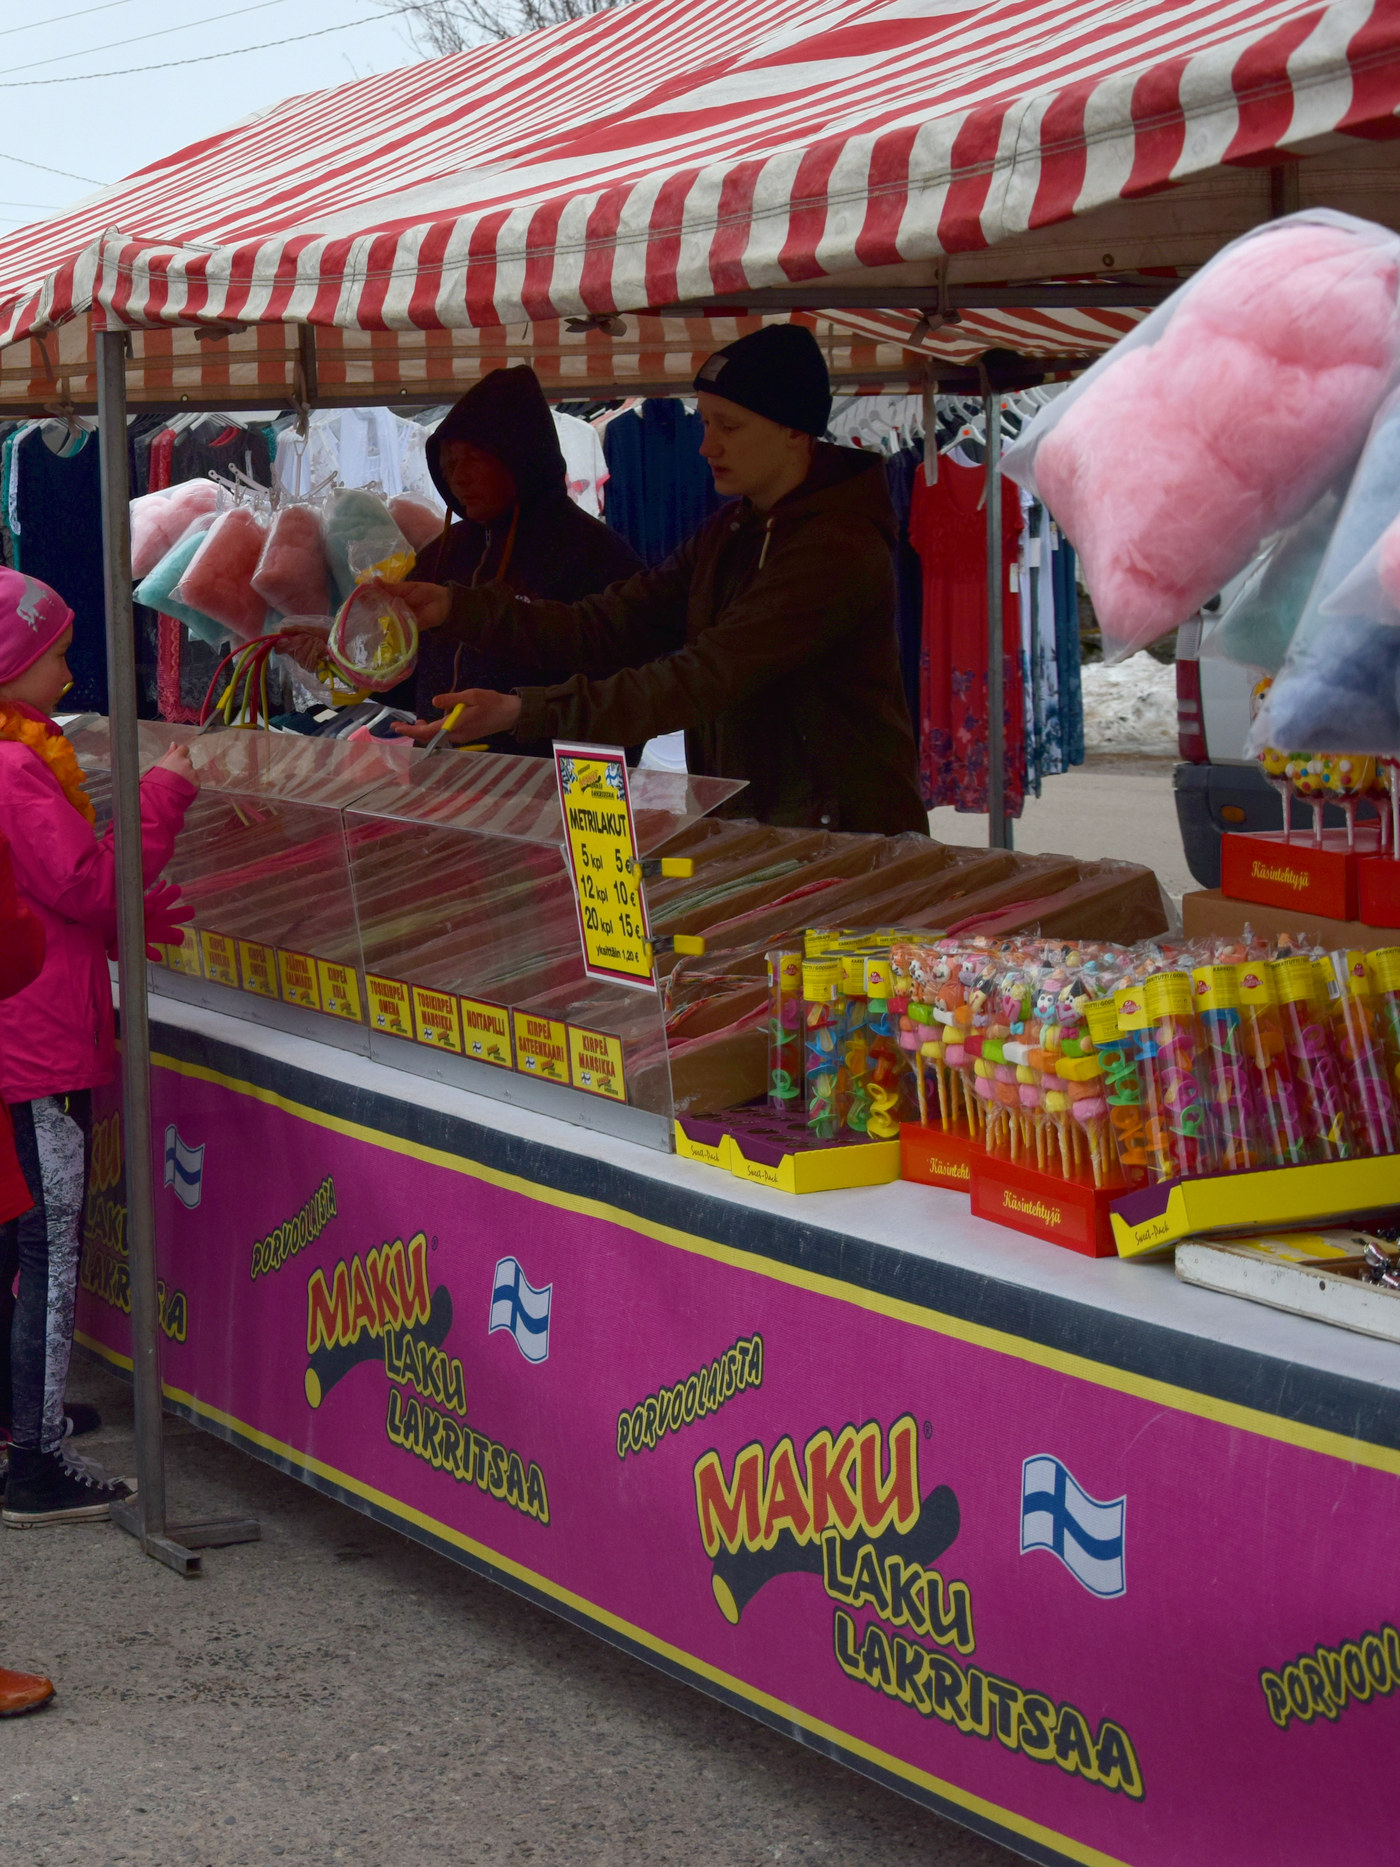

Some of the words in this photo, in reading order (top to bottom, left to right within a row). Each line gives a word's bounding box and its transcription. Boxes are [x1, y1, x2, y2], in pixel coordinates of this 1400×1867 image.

[569, 807, 627, 837] METRILAKUT
[581, 843, 589, 867] 5
[590, 854, 603, 872] kpl
[615, 849, 623, 873] 5
[581, 874, 595, 899] 12
[596, 885, 608, 904] kpl
[614, 881, 628, 906] 10
[630, 892, 636, 907] €
[1251, 860, 1310, 891] Käsintehtyjä
[585, 906, 599, 931] 20
[600, 918, 613, 937] kpl
[619, 913, 633, 938] 15
[635, 924, 641, 939] €
[596, 944, 621, 959] yksittäin
[621, 949, 634, 962] 1,20
[634, 952, 640, 963] €
[369, 979, 406, 1002] TOSIKIRPEÄ
[417, 992, 454, 1015] TOSIKIRPEÄ
[379, 998, 401, 1017] OMENA
[421, 1010, 454, 1032] MANSIKKA
[466, 1009, 506, 1037] NOITAPILLI
[526, 1020, 553, 1041] KIRPEÄ
[518, 1035, 565, 1063] SATEENKAARI
[581, 1035, 609, 1057] KIRPEÄ
[578, 1052, 616, 1078] MANSIKKA
[746, 1165, 778, 1183] Sweet-Pack
[1002, 1190, 1062, 1227] Käsintehtyjä
[250, 1175, 337, 1280] PORVOOLAISTA
[1134, 1220, 1170, 1246] Sweet-Pack
[307, 1231, 431, 1354] MAKU
[383, 1321, 467, 1417] LAKU
[618, 1332, 764, 1459] PORVOOLAISTA
[386, 1388, 550, 1527] LAKRITSAA
[693, 1412, 920, 1559] MAKU
[822, 1527, 975, 1655] LAKU
[832, 1606, 1146, 1801] LAKRITSAA
